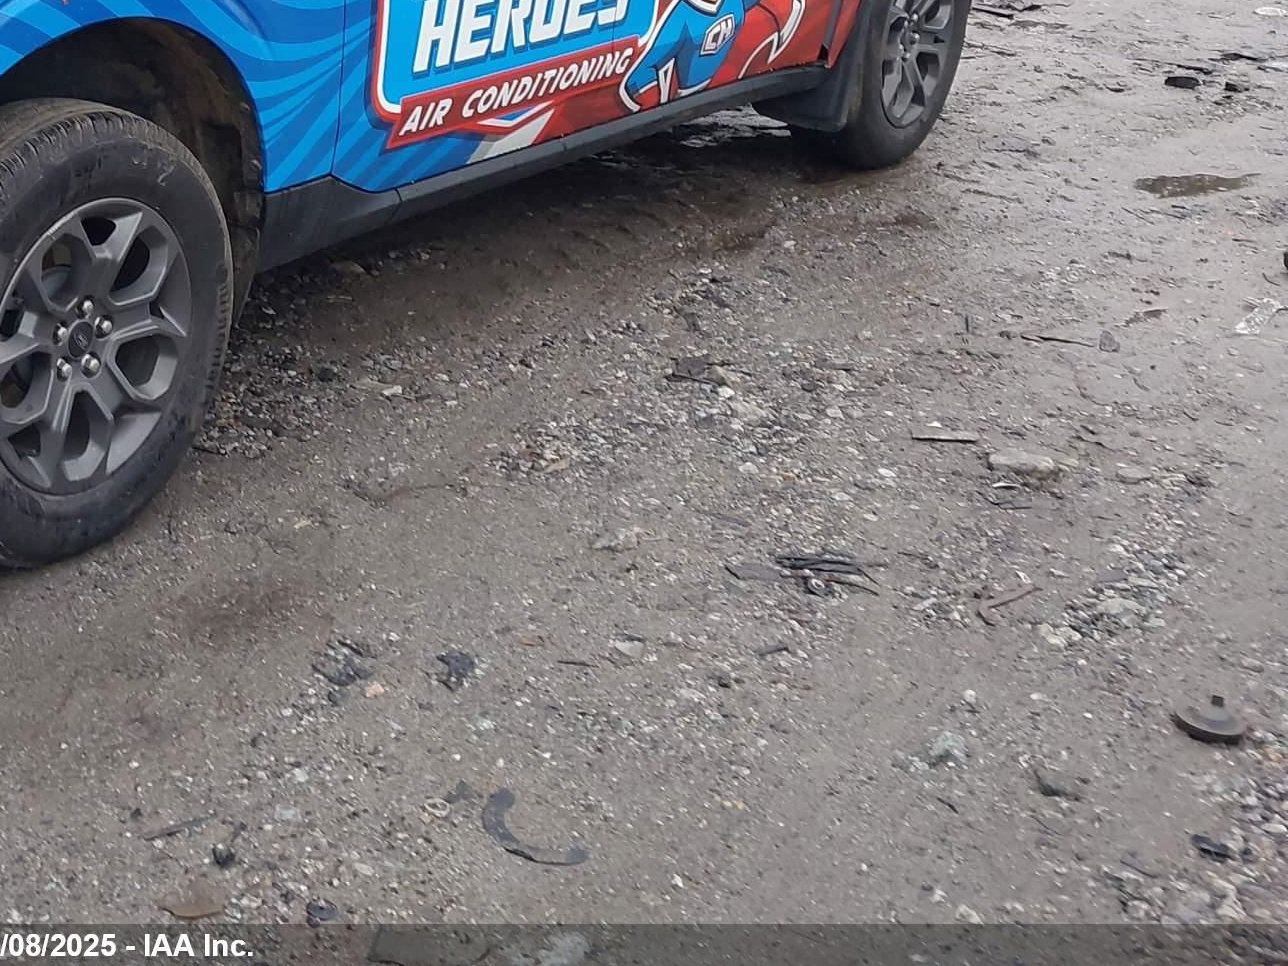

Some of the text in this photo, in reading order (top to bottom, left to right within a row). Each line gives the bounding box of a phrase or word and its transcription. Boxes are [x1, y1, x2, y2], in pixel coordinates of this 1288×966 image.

[705, 18, 733, 51] CH
[398, 47, 634, 136] AIR CONDITIONING
